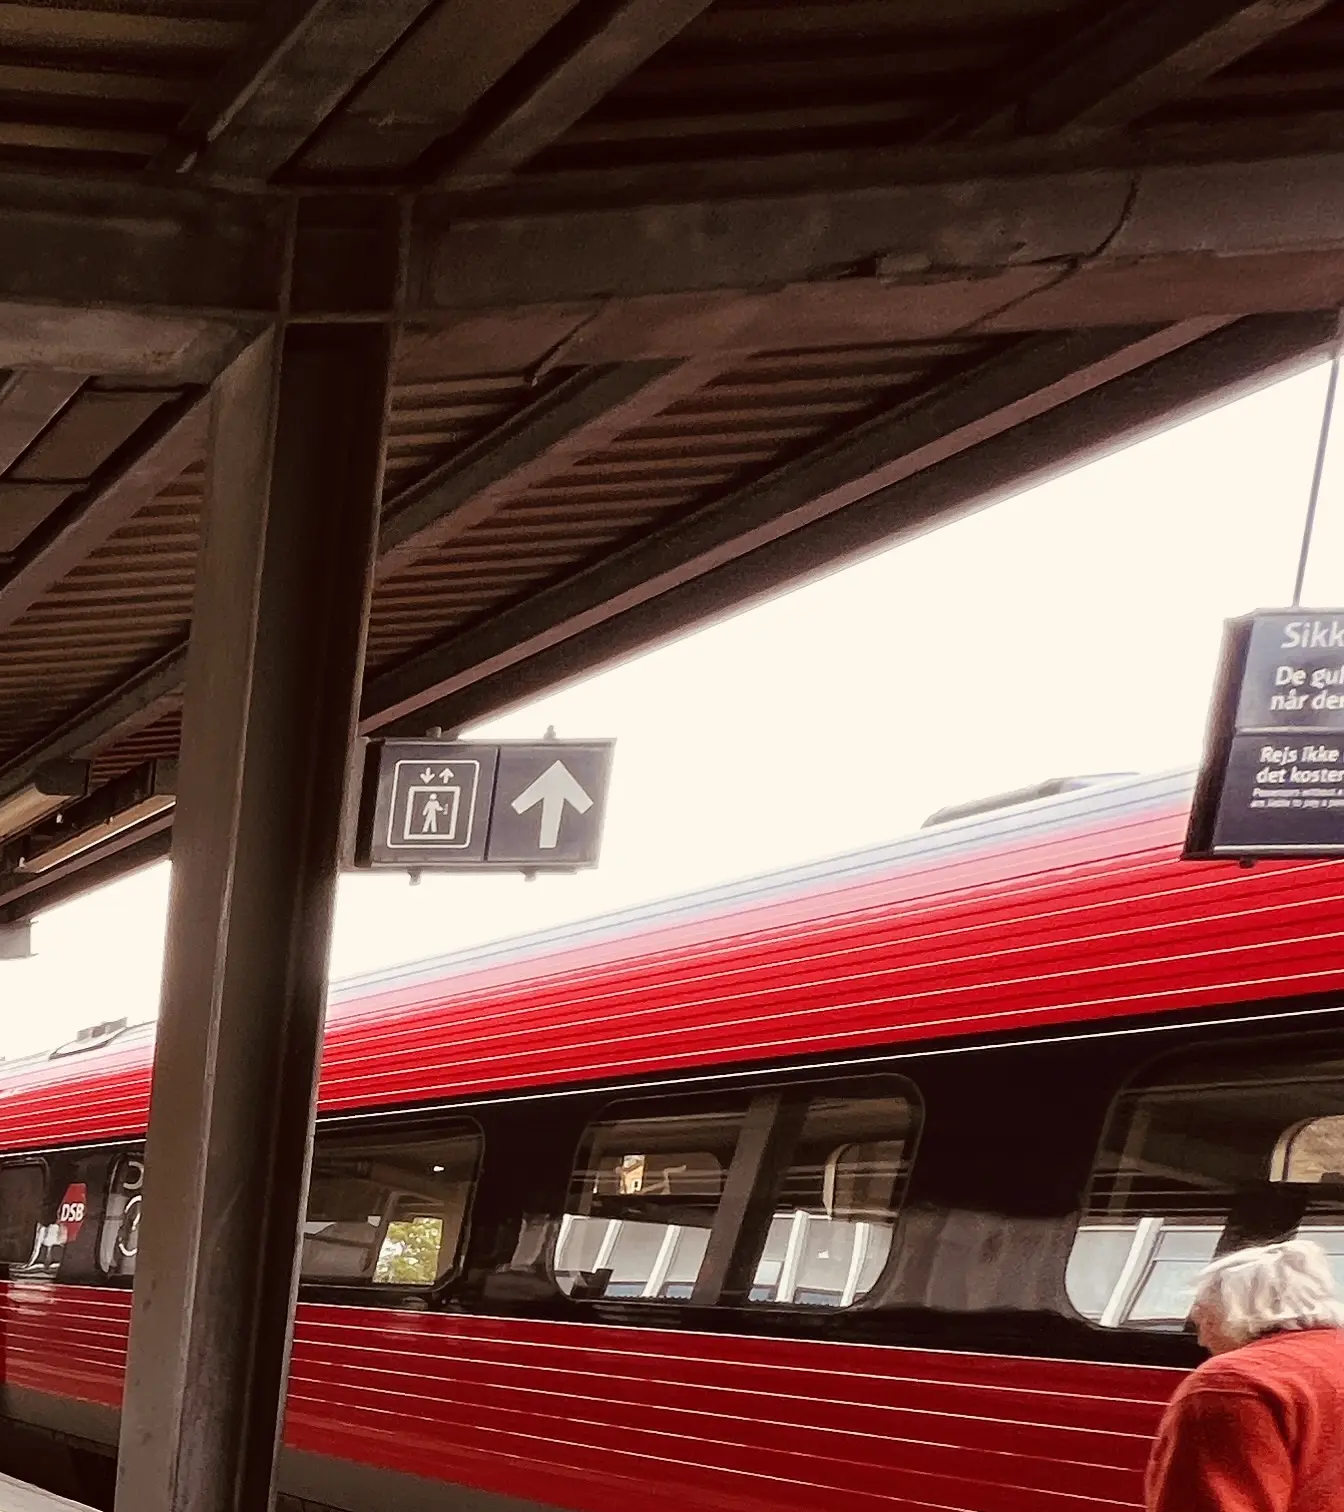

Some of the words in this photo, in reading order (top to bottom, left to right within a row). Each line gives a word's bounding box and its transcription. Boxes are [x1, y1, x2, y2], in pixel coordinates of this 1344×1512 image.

[1275, 665, 1306, 686] De
[1270, 688, 1309, 710] når
[1259, 746, 1298, 766] Rejs
[1256, 766, 1287, 784] det
[60, 1202, 85, 1222] DSB
